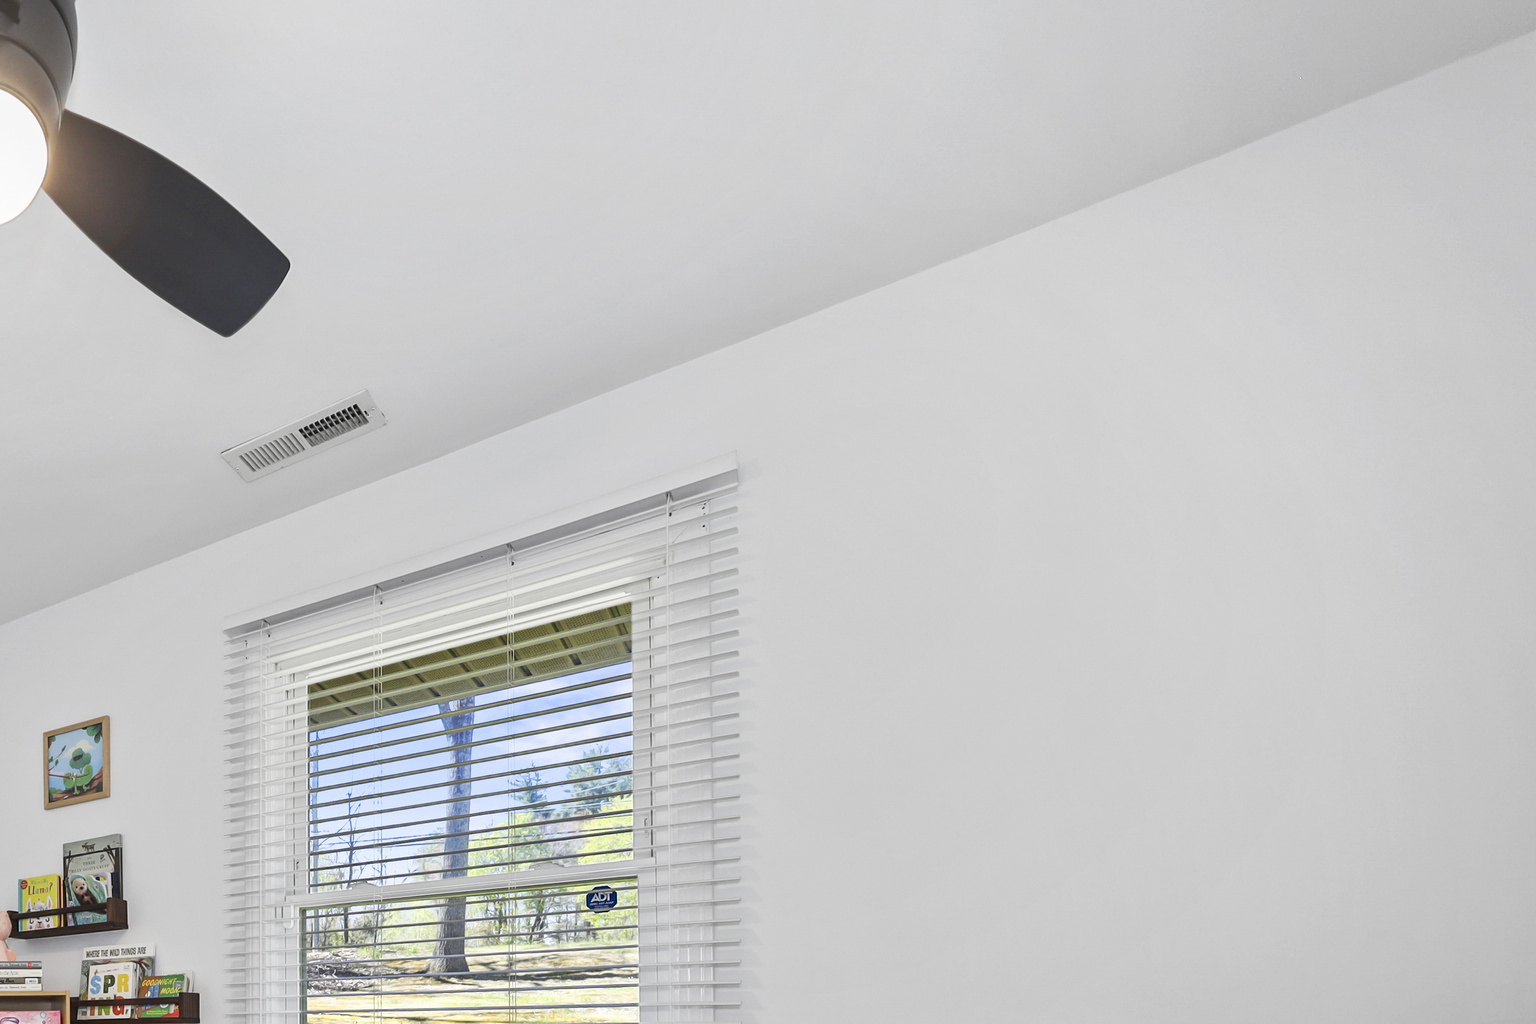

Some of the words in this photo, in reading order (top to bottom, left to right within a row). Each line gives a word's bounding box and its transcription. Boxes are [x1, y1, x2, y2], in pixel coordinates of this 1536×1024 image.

[28, 882, 53, 895] Llama?
[591, 891, 613, 902] ADT
[86, 950, 100, 958] WHERE
[101, 949, 109, 957] THE
[109, 948, 120, 957] WILD
[121, 947, 137, 956] THINGS
[137, 946, 147, 955] ARE
[90, 973, 130, 995] SPR
[141, 978, 178, 987] GOODNIGHT
[160, 987, 180, 995] MOON
